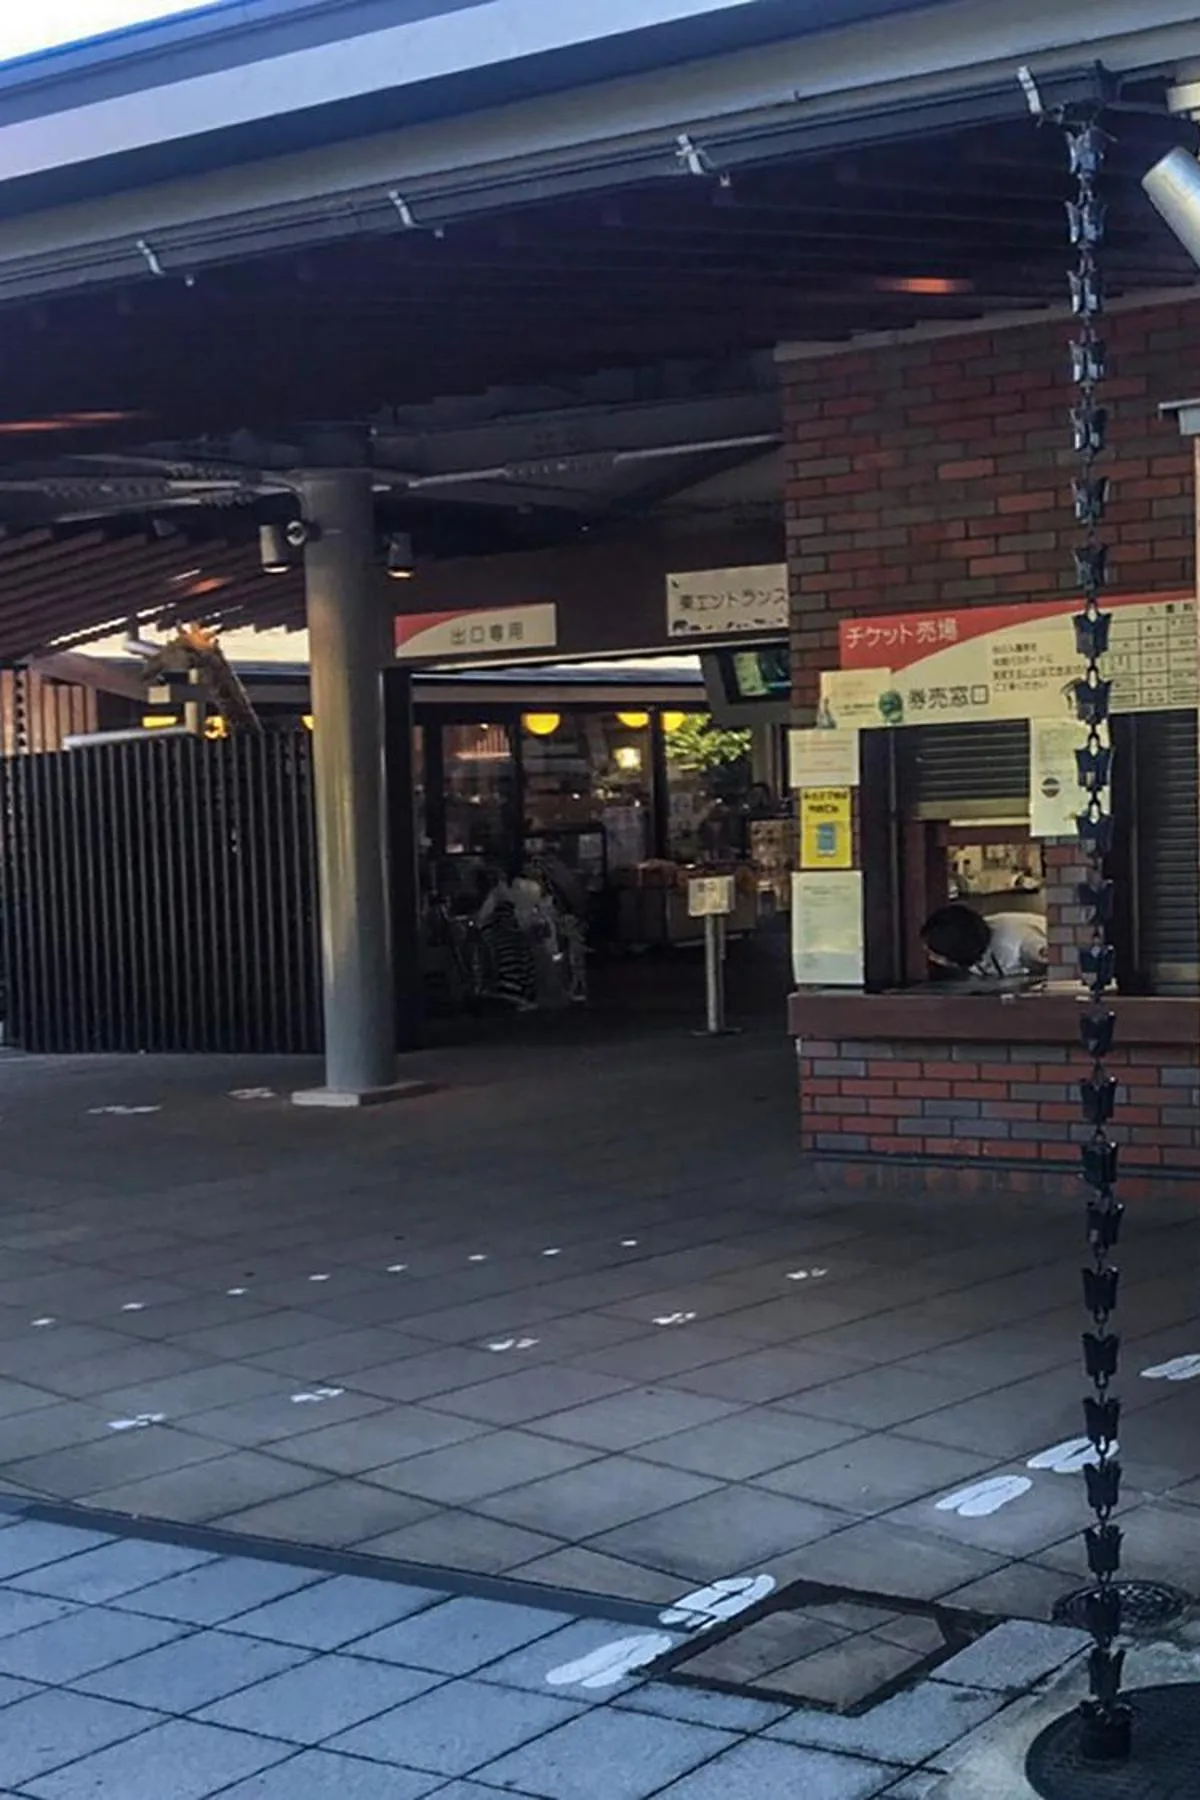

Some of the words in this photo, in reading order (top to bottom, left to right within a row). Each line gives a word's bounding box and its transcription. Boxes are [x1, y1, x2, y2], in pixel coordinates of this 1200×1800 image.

[451, 621, 523, 646] 出口専用
[908, 684, 989, 710] 券売窓口
